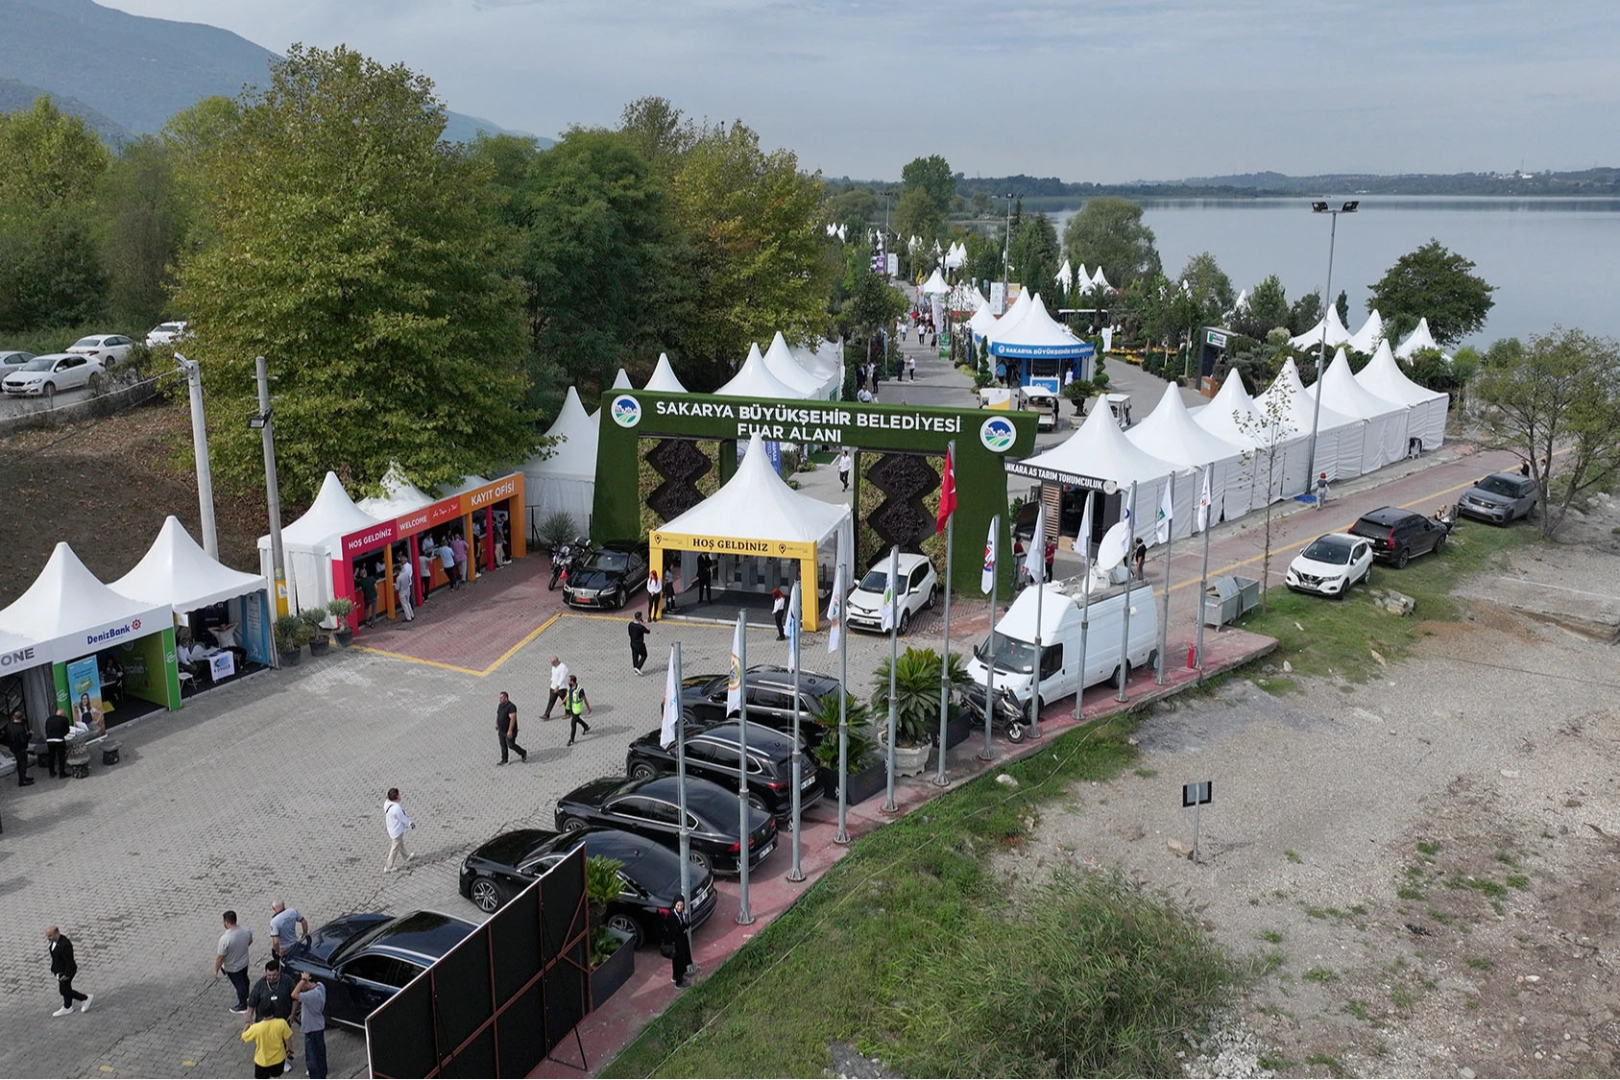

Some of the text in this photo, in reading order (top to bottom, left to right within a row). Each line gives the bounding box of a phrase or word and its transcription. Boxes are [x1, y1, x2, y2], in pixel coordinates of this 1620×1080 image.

[656, 400, 961, 433] SAKARYA BÜYÜKŞEHİR BELEDİYESİ
[737, 423, 842, 443] FUAR ALANI
[1038, 469, 1057, 481] TARIM
[1059, 474, 1103, 490] TOHUMCULUK
[471, 479, 515, 506] KAYIT OFİSİ
[399, 514, 428, 531] WELCOME
[348, 527, 392, 550] HOŞ GELDİNİZ
[692, 538, 714, 550] HOŞ
[717, 539, 769, 552] GELDİNİZ
[87, 624, 131, 645] DenizBank
[0, 648, 35, 667] ONE
